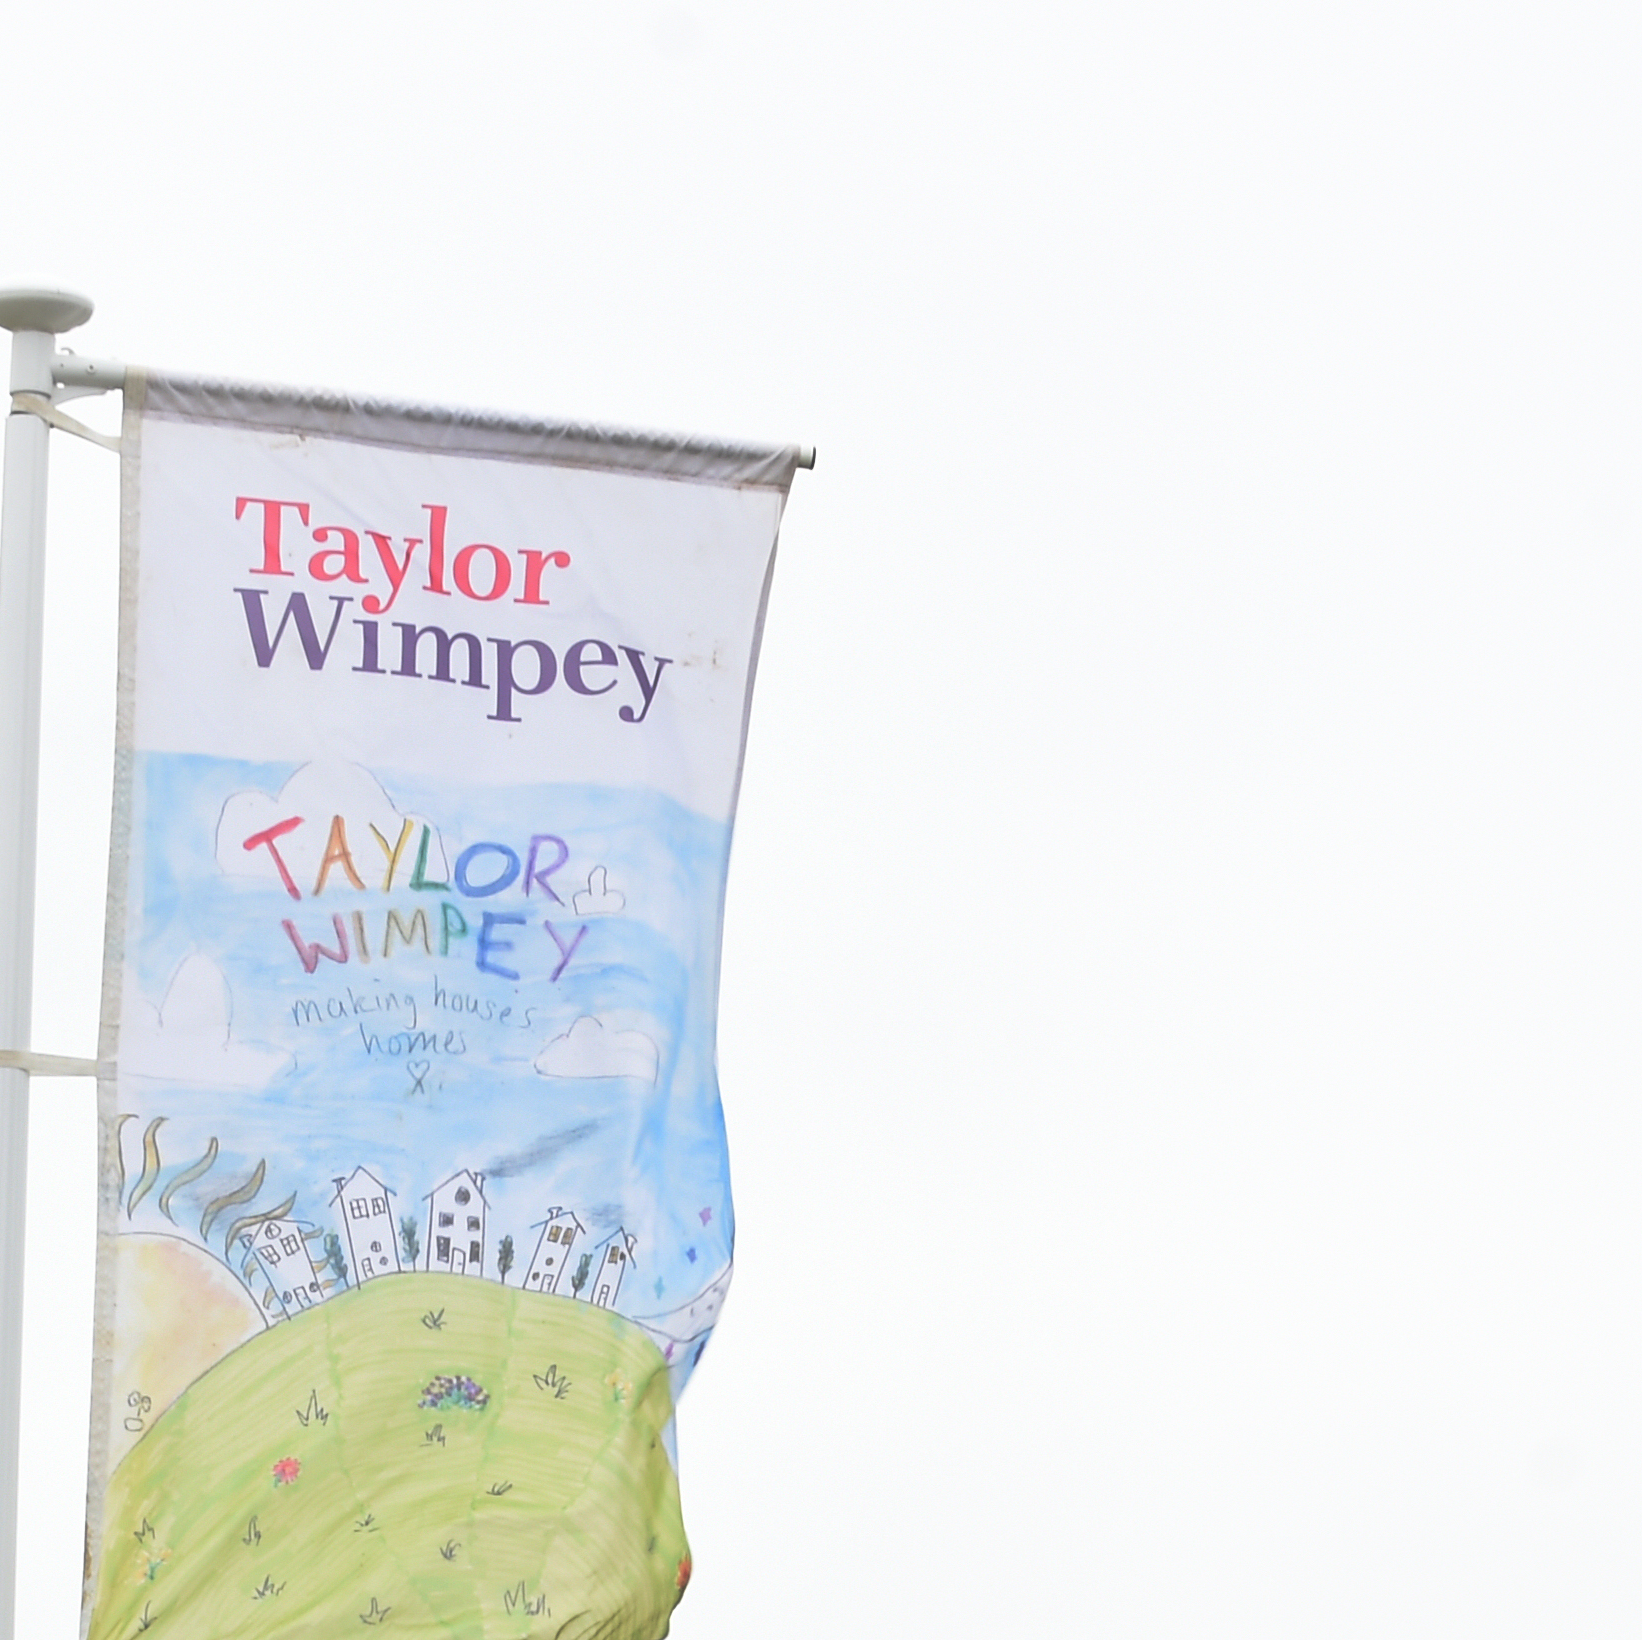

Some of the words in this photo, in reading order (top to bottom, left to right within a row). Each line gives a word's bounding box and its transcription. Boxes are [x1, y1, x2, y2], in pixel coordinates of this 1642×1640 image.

[235, 496, 571, 615] Taylor
[233, 588, 674, 723] Wimpey
[243, 814, 570, 907] TAYLOR
[281, 902, 589, 982] WIMPEY
[291, 977, 418, 1030] making
[359, 1022, 468, 1056] homes
